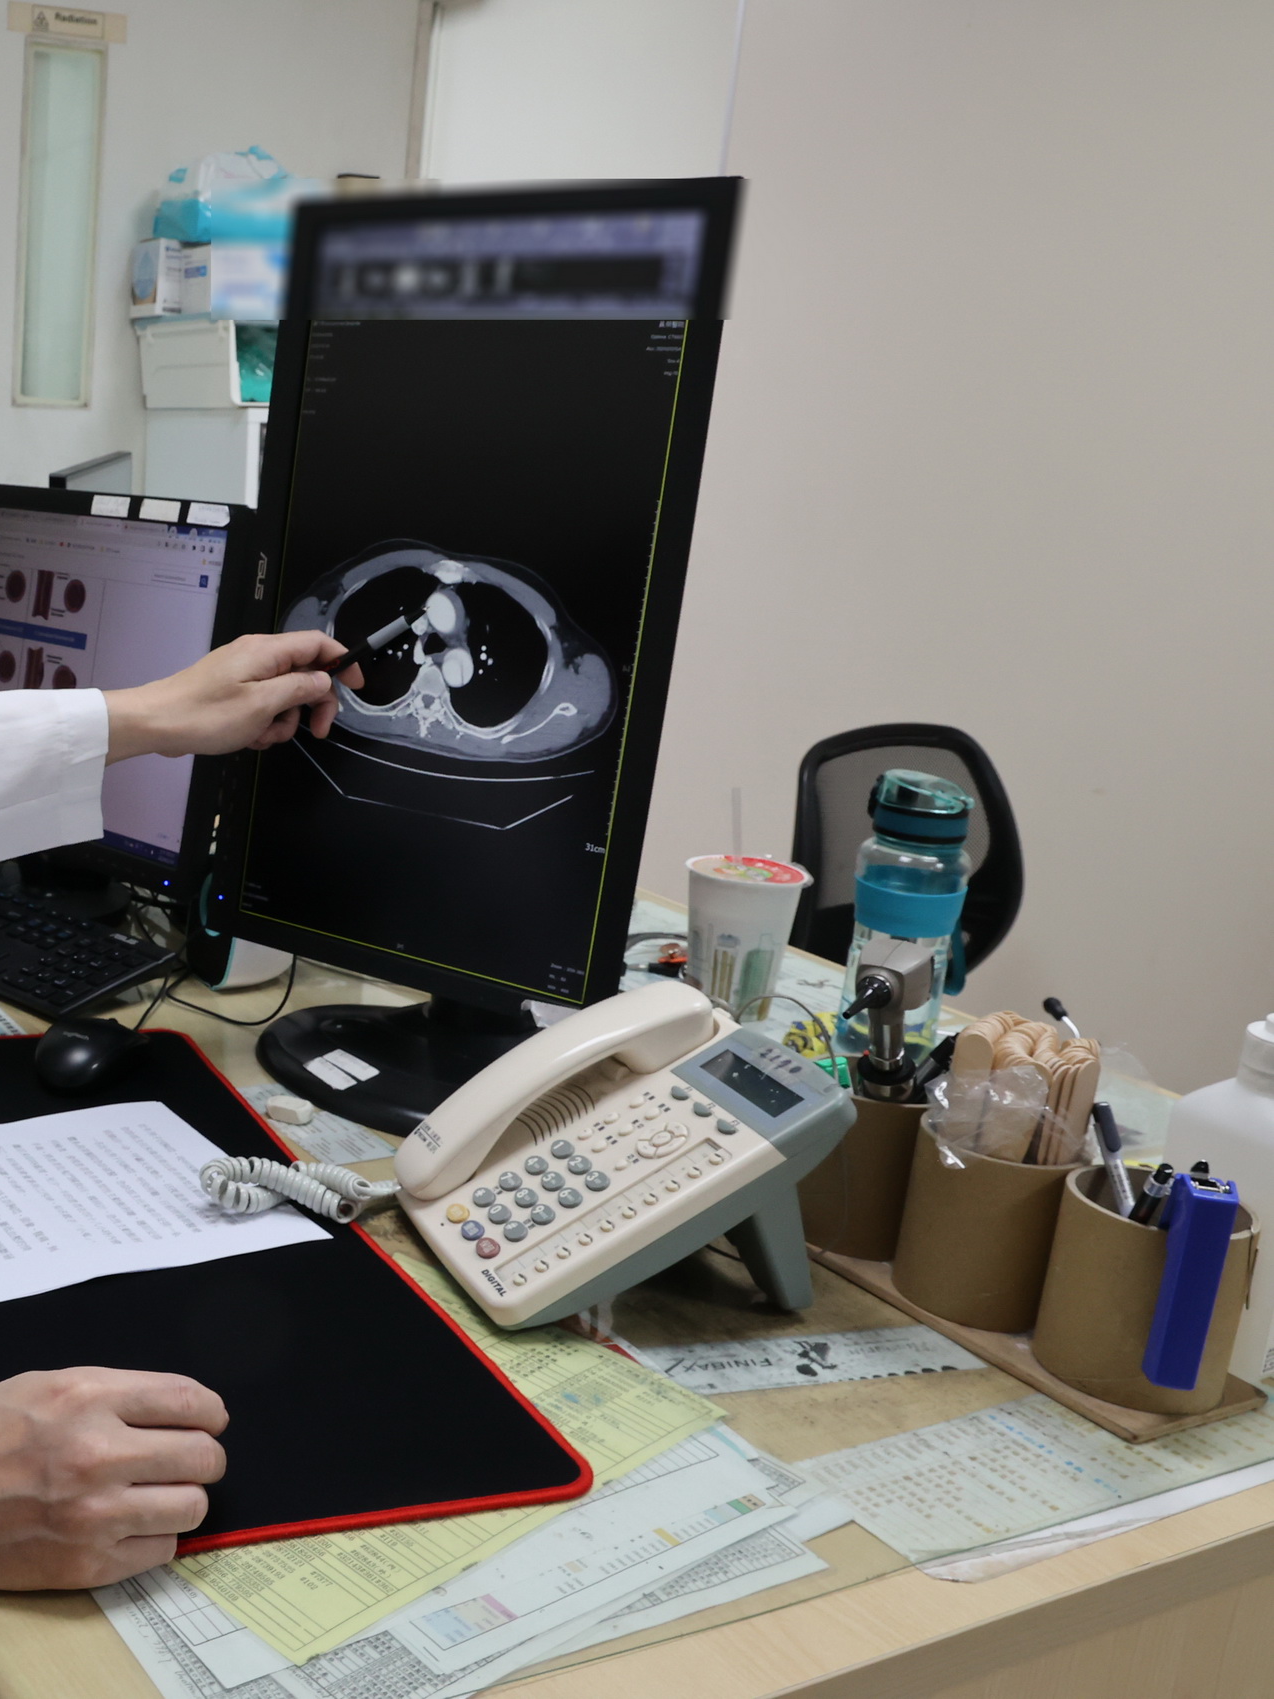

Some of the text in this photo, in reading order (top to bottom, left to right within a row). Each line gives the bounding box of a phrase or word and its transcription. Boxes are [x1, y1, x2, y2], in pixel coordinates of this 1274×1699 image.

[54, 12, 98, 25] Radiation
[254, 551, 267, 602] ASUS
[585, 842, 606, 854] 31cm
[480, 1268, 509, 1298] DIGITAL
[682, 1356, 773, 1375] FINIBAX
